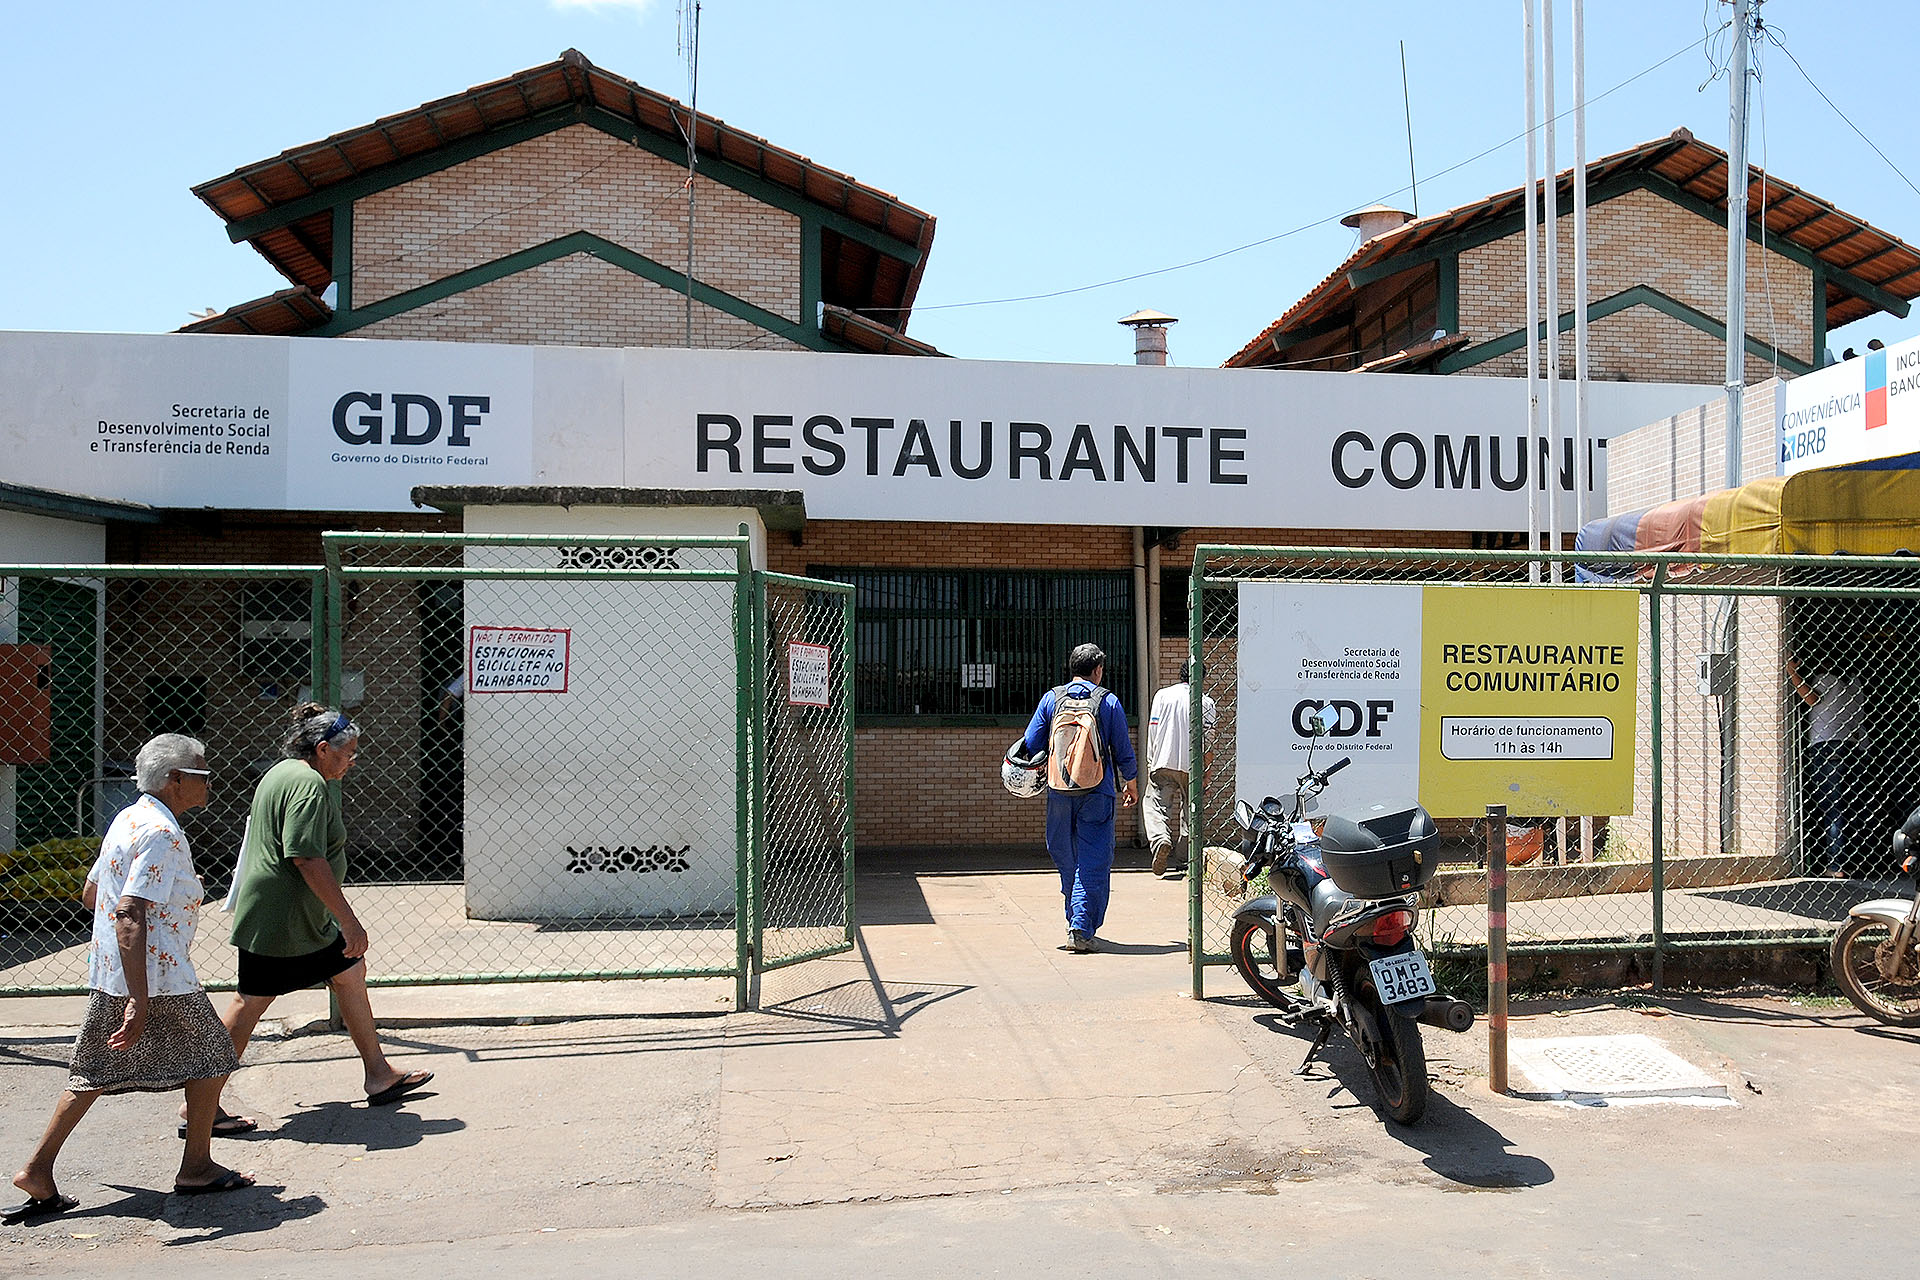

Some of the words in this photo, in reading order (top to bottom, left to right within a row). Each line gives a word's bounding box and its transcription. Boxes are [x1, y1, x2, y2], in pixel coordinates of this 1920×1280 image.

[172, 404, 246, 419] Secretaria
[253, 406, 270, 419] de
[332, 391, 490, 446] GDF
[1782, 393, 1861, 431] CONVENIÊNCIA
[98, 421, 224, 436] Desenvolvimento
[228, 423, 270, 437] Social
[90, 442, 98, 452] e
[103, 439, 201, 454] Transferência
[205, 441, 222, 454] de
[226, 442, 270, 455] Renda
[697, 413, 1248, 485] RESTAURANTE
[1797, 426, 1826, 458] BRB
[331, 453, 380, 463] Governo
[384, 454, 398, 463] do
[402, 455, 443, 465] Distrito
[447, 456, 488, 465] Federal
[506, 633, 556, 644] PERMITIDO
[475, 646, 556, 659] ESTACIONAR
[1344, 647, 1386, 657] Secretaria
[1389, 648, 1400, 657] de
[1443, 644, 1624, 665] RESTAURANTE
[477, 659, 541, 672] BICICLETA
[545, 662, 564, 672] NO
[1302, 659, 1374, 668] Desenvolvimento
[1375, 659, 1400, 668] Social
[475, 674, 550, 687] ALANBRADO
[1297, 671, 1303, 679] e
[1305, 670, 1361, 679] Transferência
[1362, 670, 1373, 679] de
[1374, 671, 1400, 679] Renda
[1446, 667, 1620, 692] COMUNITÁRIO
[1291, 699, 1394, 737] GDF
[1451, 725, 1495, 736] Horário
[1499, 725, 1513, 736] de
[1516, 725, 1603, 737] funcionamento
[1291, 743, 1324, 751] Goveno
[1325, 743, 1335, 751] do
[1337, 743, 1364, 751] Distrito
[1365, 743, 1393, 751] Federal
[1494, 742, 1516, 753] 11h
[1520, 742, 1535, 754] às
[1541, 742, 1562, 753] 14h
[1381, 963, 1420, 985] OMP
[1384, 977, 1429, 1000] 3483
